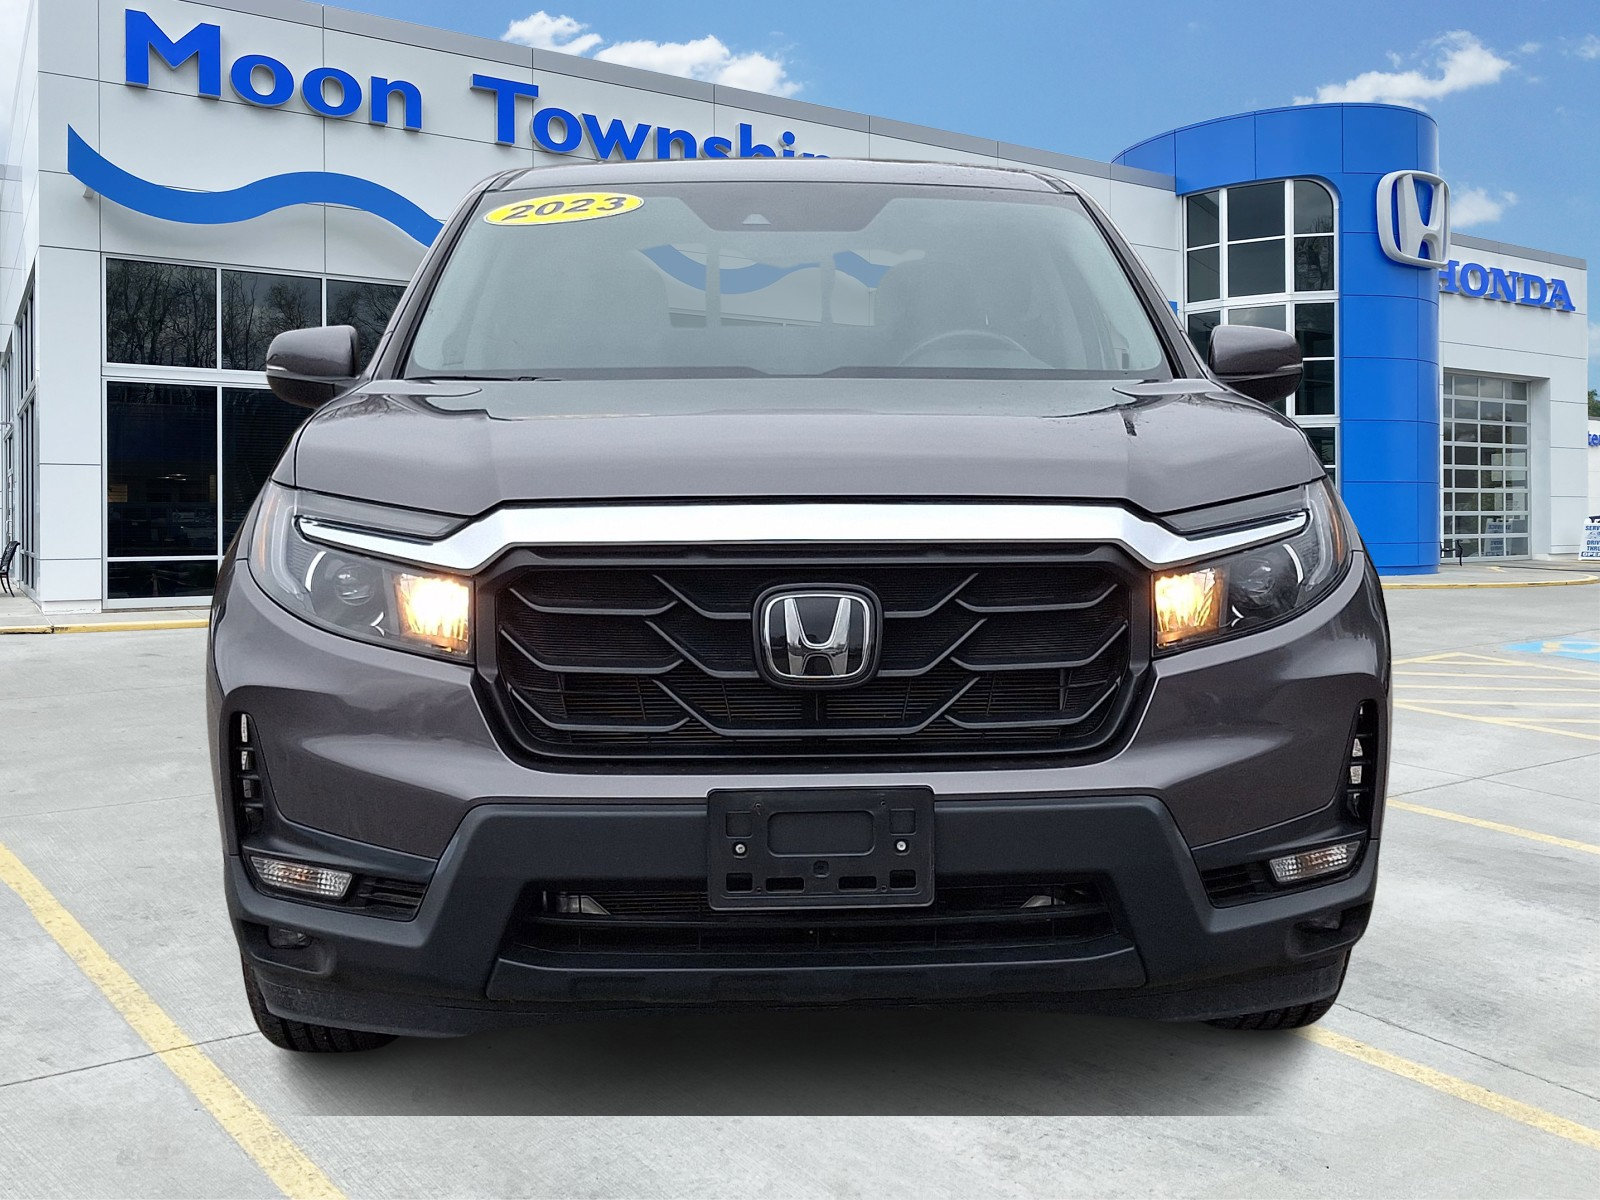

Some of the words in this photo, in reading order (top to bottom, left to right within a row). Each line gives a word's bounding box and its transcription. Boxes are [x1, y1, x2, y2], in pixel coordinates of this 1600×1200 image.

[125, 8, 422, 131] Moon
[470, 73, 832, 160] Townshi
[502, 197, 627, 221] 2023
[1439, 260, 1576, 311] HONDA
